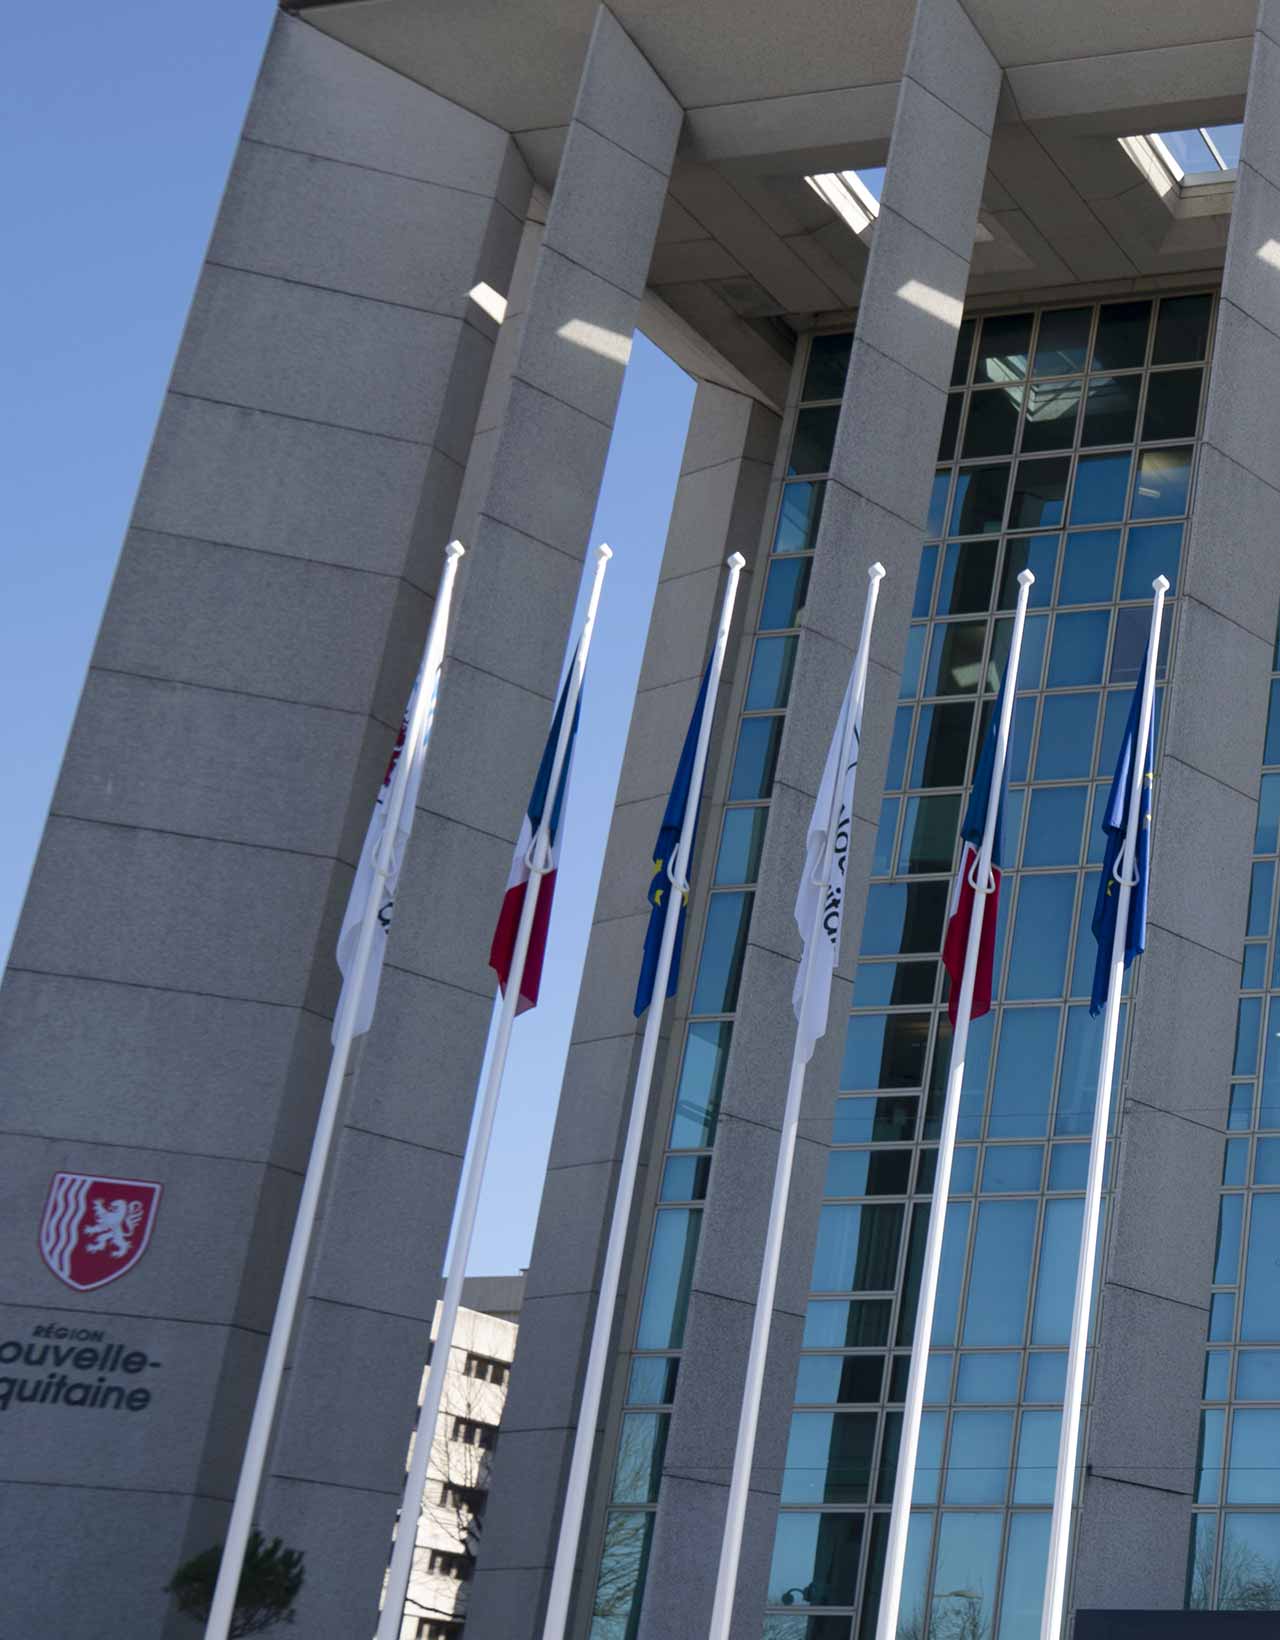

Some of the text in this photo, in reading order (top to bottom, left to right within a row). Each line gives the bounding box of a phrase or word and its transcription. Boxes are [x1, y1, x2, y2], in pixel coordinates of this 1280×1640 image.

[32, 1322, 105, 1342] RÉGION
[0, 1340, 162, 1374] ouvelle-
[0, 1373, 151, 1412] quitaine
